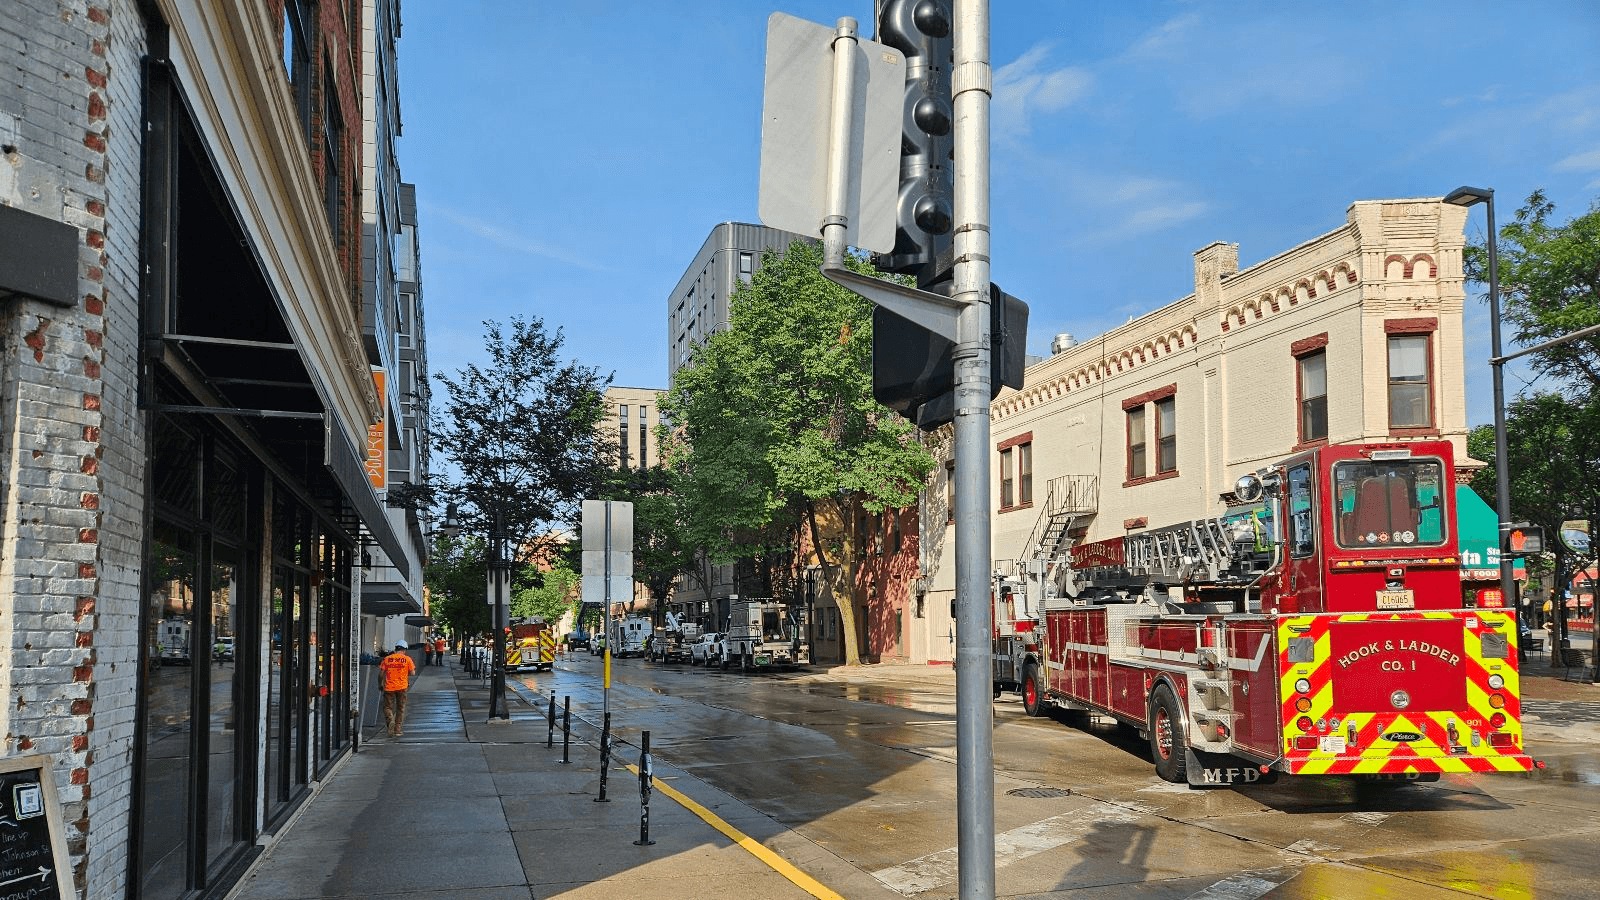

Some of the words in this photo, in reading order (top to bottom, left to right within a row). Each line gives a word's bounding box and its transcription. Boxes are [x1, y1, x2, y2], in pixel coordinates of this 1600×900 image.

[1486, 547, 1500, 555] Sta
[1487, 556, 1500, 564] Str
[1338, 642, 1380, 669] HOOK
[1384, 640, 1394, 650] &
[1399, 639, 1460, 667] LADDER
[1381, 660, 1405, 671] CO.
[1466, 719, 1482, 727] 901
[1203, 767, 1261, 783] MFD
